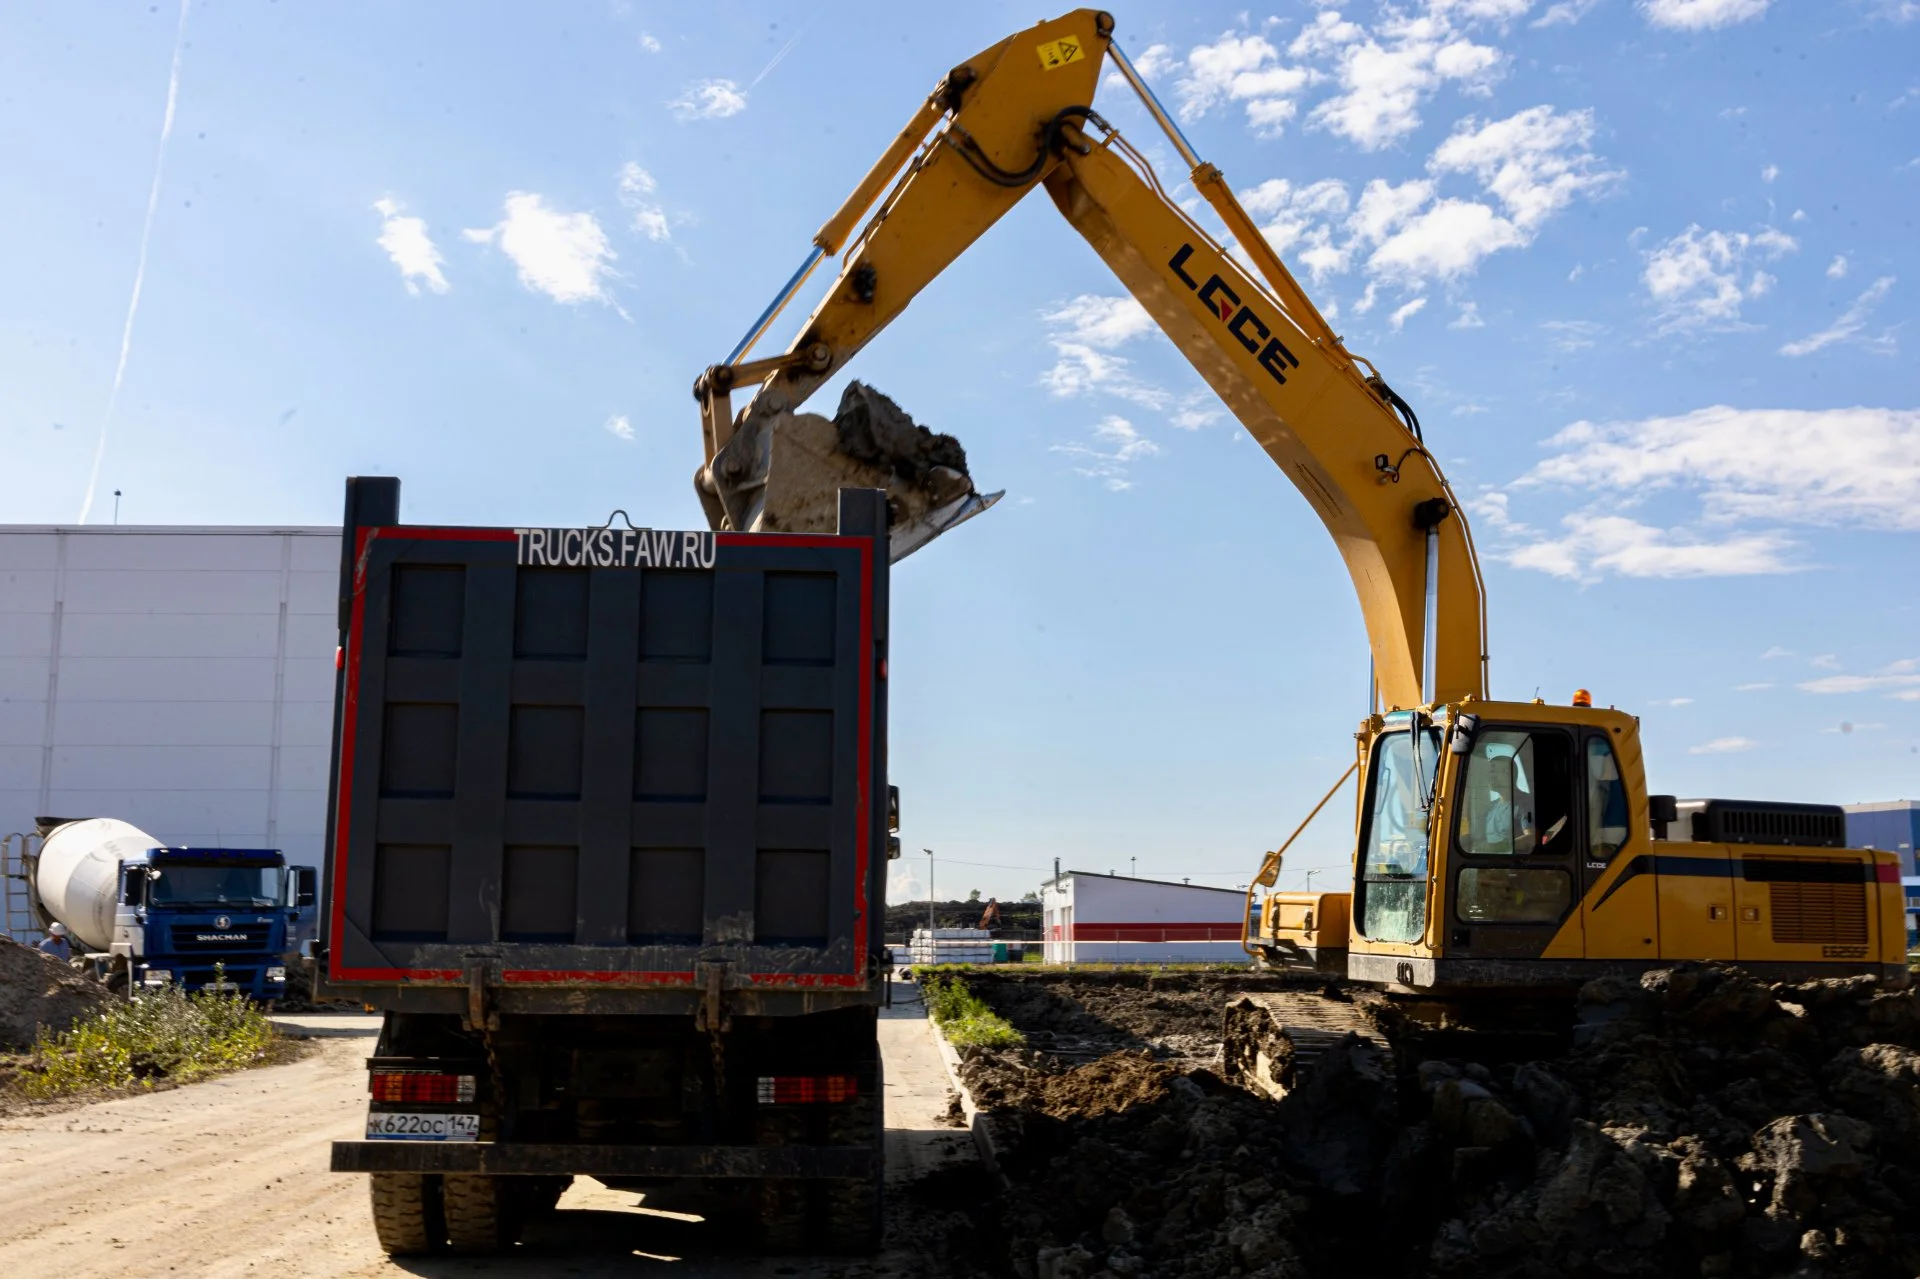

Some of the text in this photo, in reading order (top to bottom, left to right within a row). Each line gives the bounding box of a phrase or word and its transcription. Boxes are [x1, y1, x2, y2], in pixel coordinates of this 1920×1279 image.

[1168, 243, 1300, 385] LGCE
[514, 528, 717, 569] TRUCKS.FAW.RU
[196, 934, 248, 942] SHACMAN
[448, 1116, 475, 1130] 147
